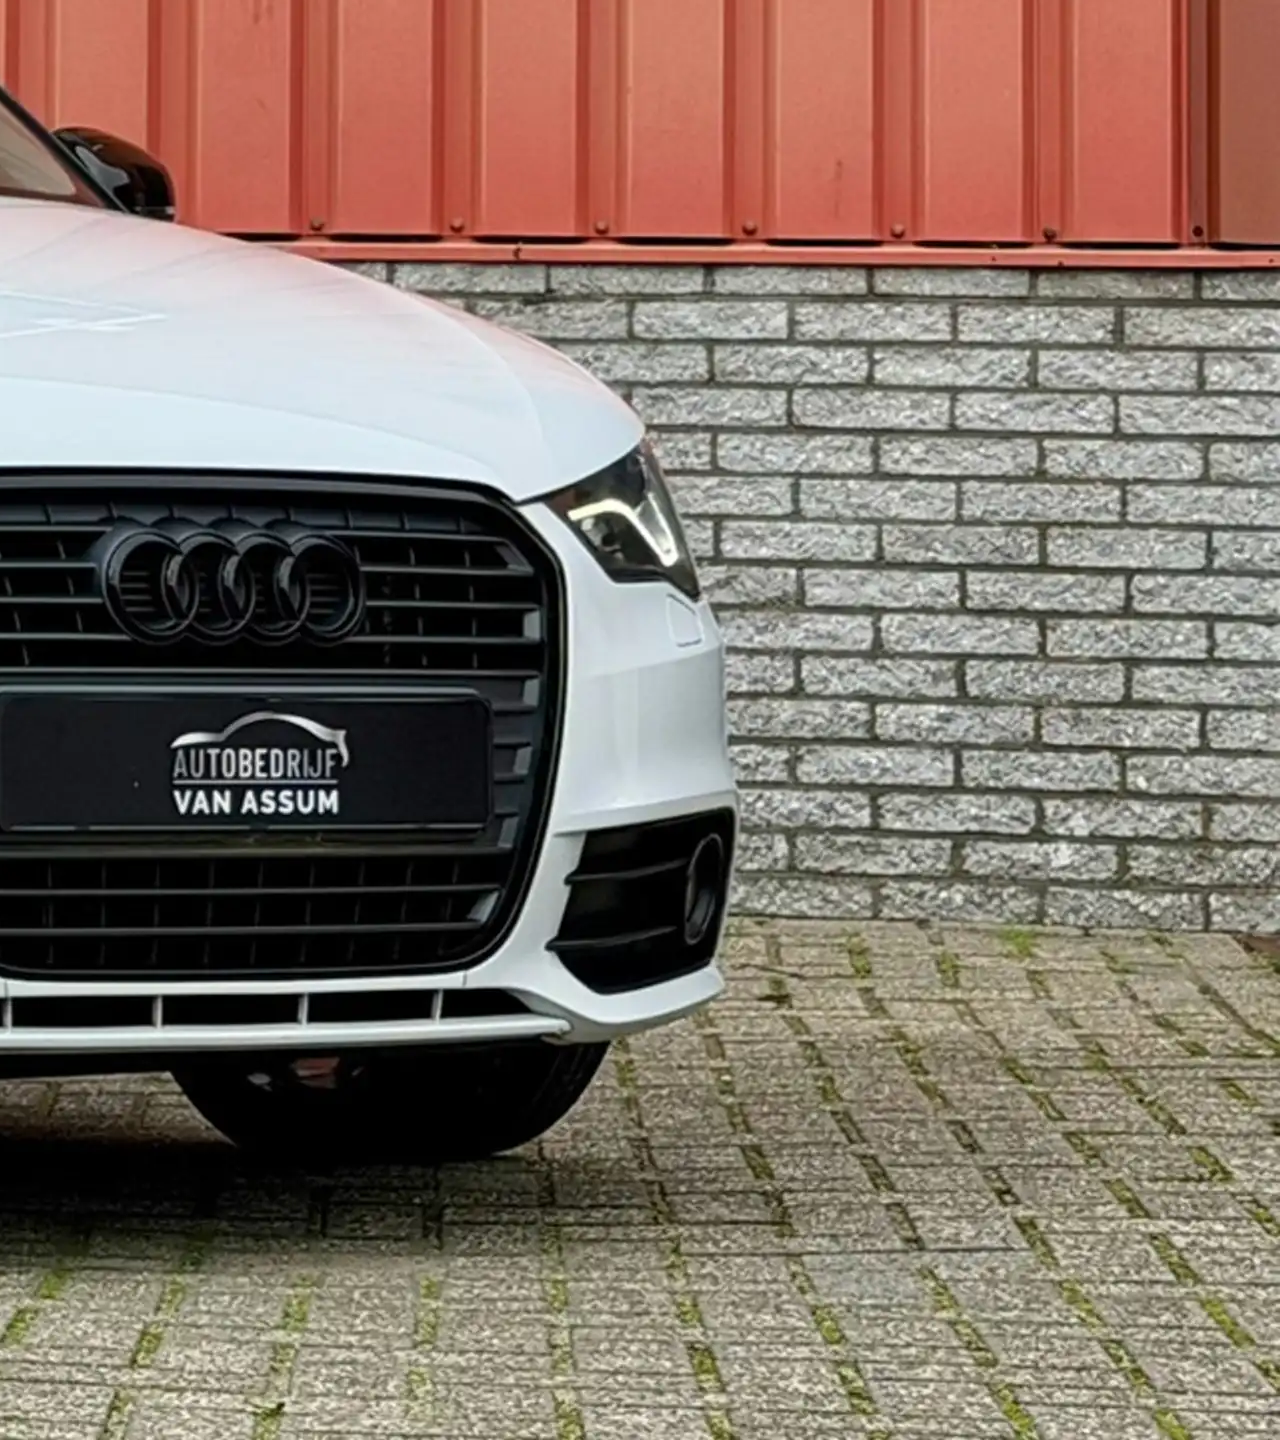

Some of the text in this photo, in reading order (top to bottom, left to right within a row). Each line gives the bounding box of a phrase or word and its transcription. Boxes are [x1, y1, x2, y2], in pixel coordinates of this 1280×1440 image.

[173, 748, 338, 778] AUTOBEDRIJF
[173, 789, 339, 815] VAN ASSUM
